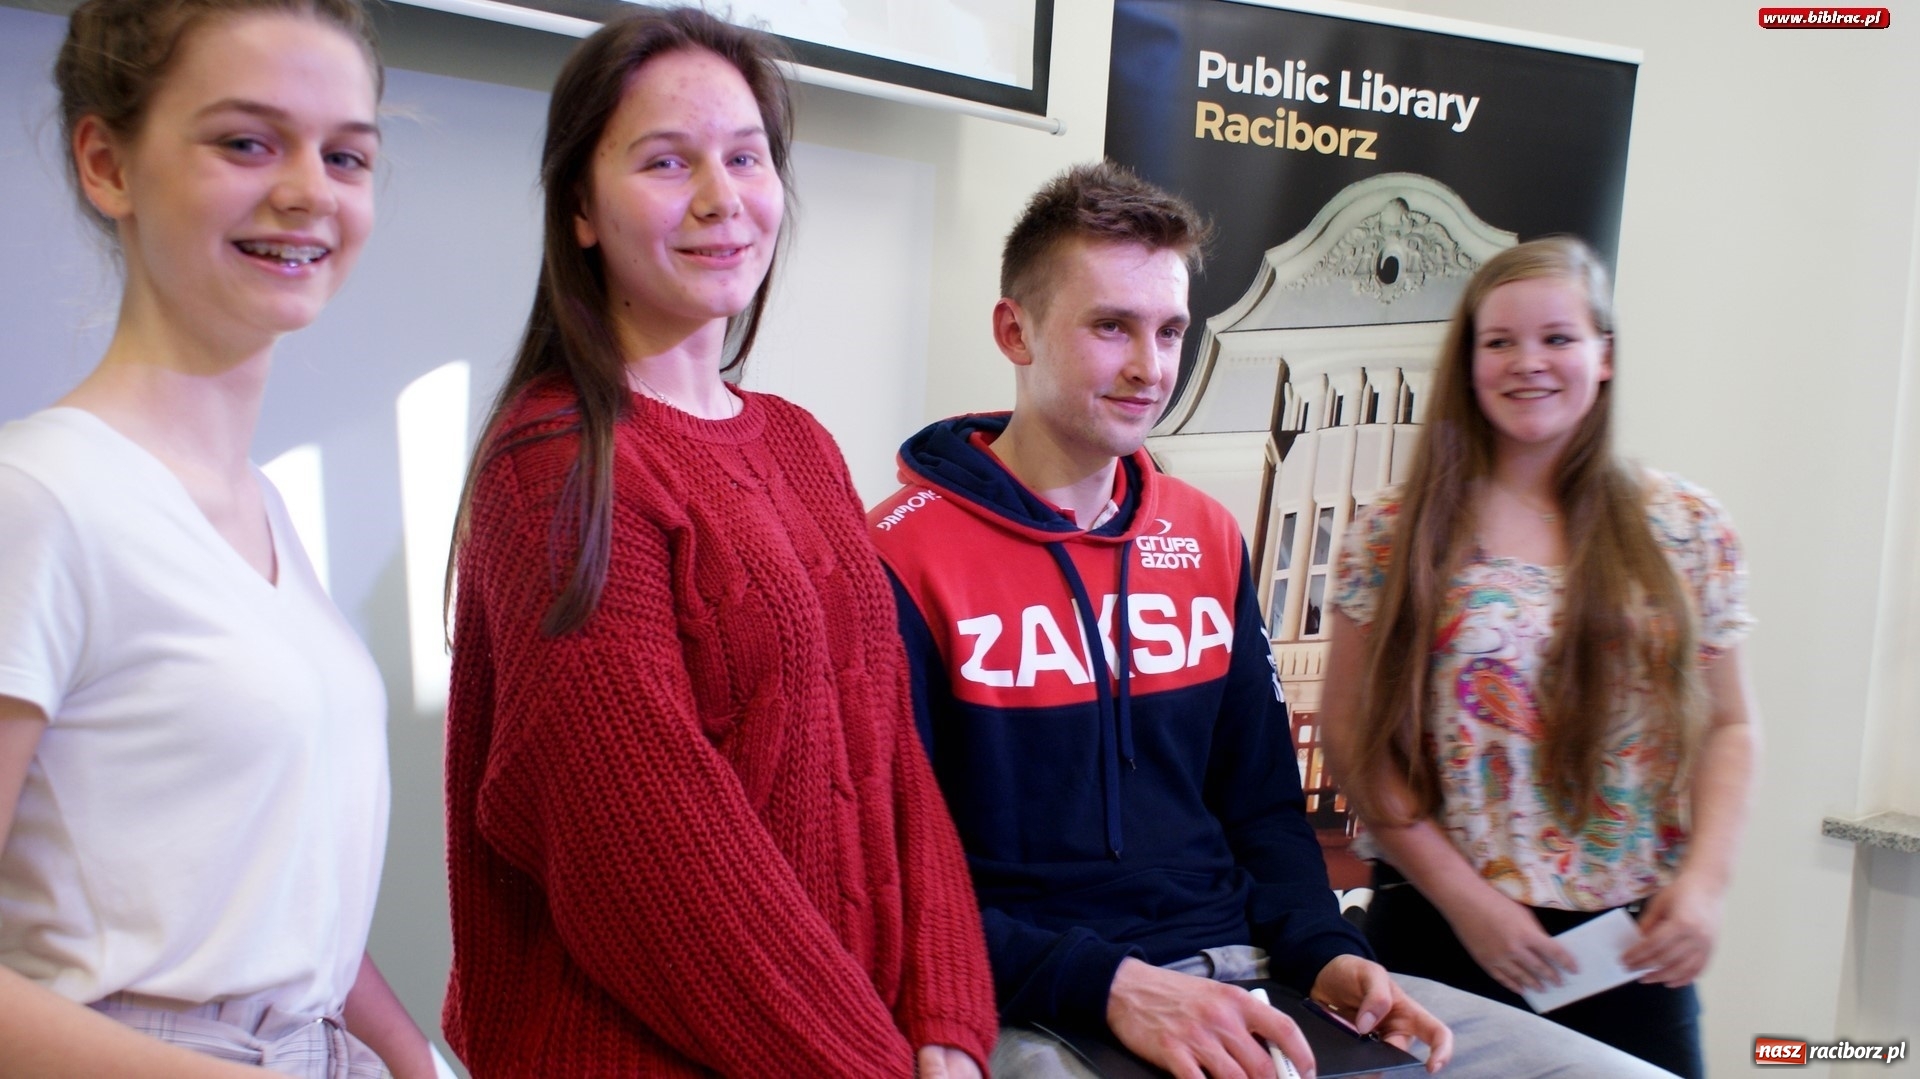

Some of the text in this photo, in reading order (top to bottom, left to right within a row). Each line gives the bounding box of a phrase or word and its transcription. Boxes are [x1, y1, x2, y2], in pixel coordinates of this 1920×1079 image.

[1197, 50, 1480, 133] Public Library
[1195, 102, 1377, 160] Raciborz
